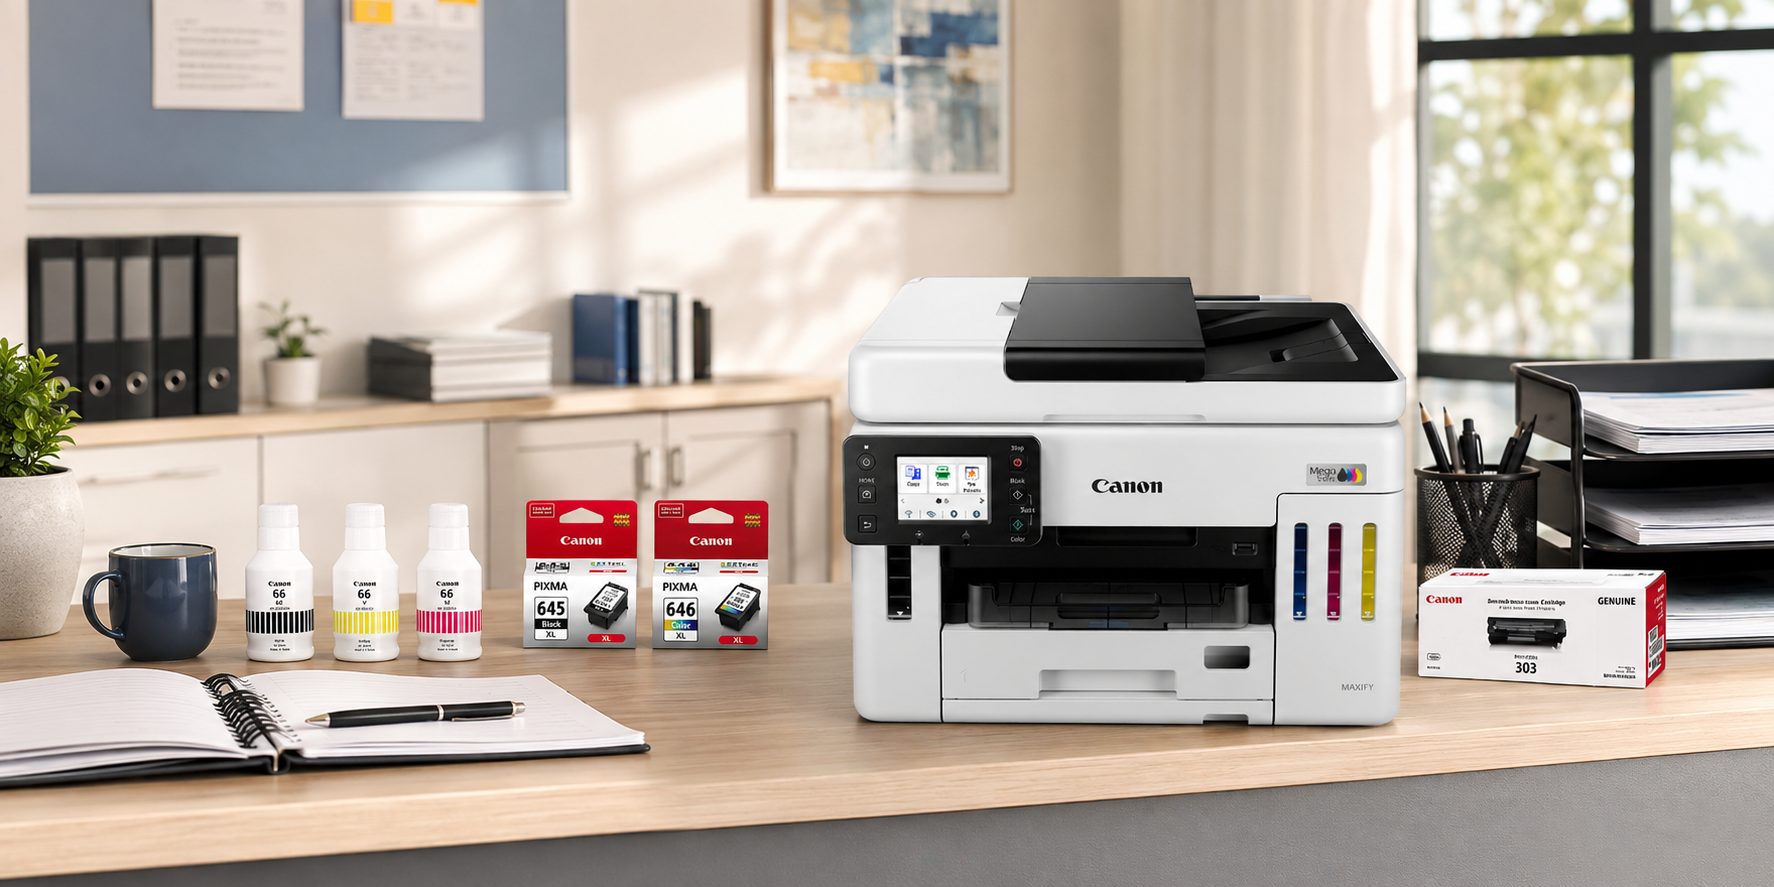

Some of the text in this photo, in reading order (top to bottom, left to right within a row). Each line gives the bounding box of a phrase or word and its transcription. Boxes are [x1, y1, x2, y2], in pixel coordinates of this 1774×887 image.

[1092, 478, 1163, 494] Canon
[560, 536, 602, 545] Canon
[689, 536, 732, 546] Canon
[534, 581, 568, 591] PIXMA
[663, 582, 698, 592] PIXMA
[272, 589, 286, 598] 66
[357, 589, 371, 599] 66
[440, 589, 454, 598] 66
[1426, 594, 1462, 604] Canon
[1597, 596, 1636, 605] GENUINE
[537, 601, 565, 616] 645
[666, 601, 696, 617] 646
[676, 632, 686, 640] XL
[1515, 662, 1537, 674] 303
